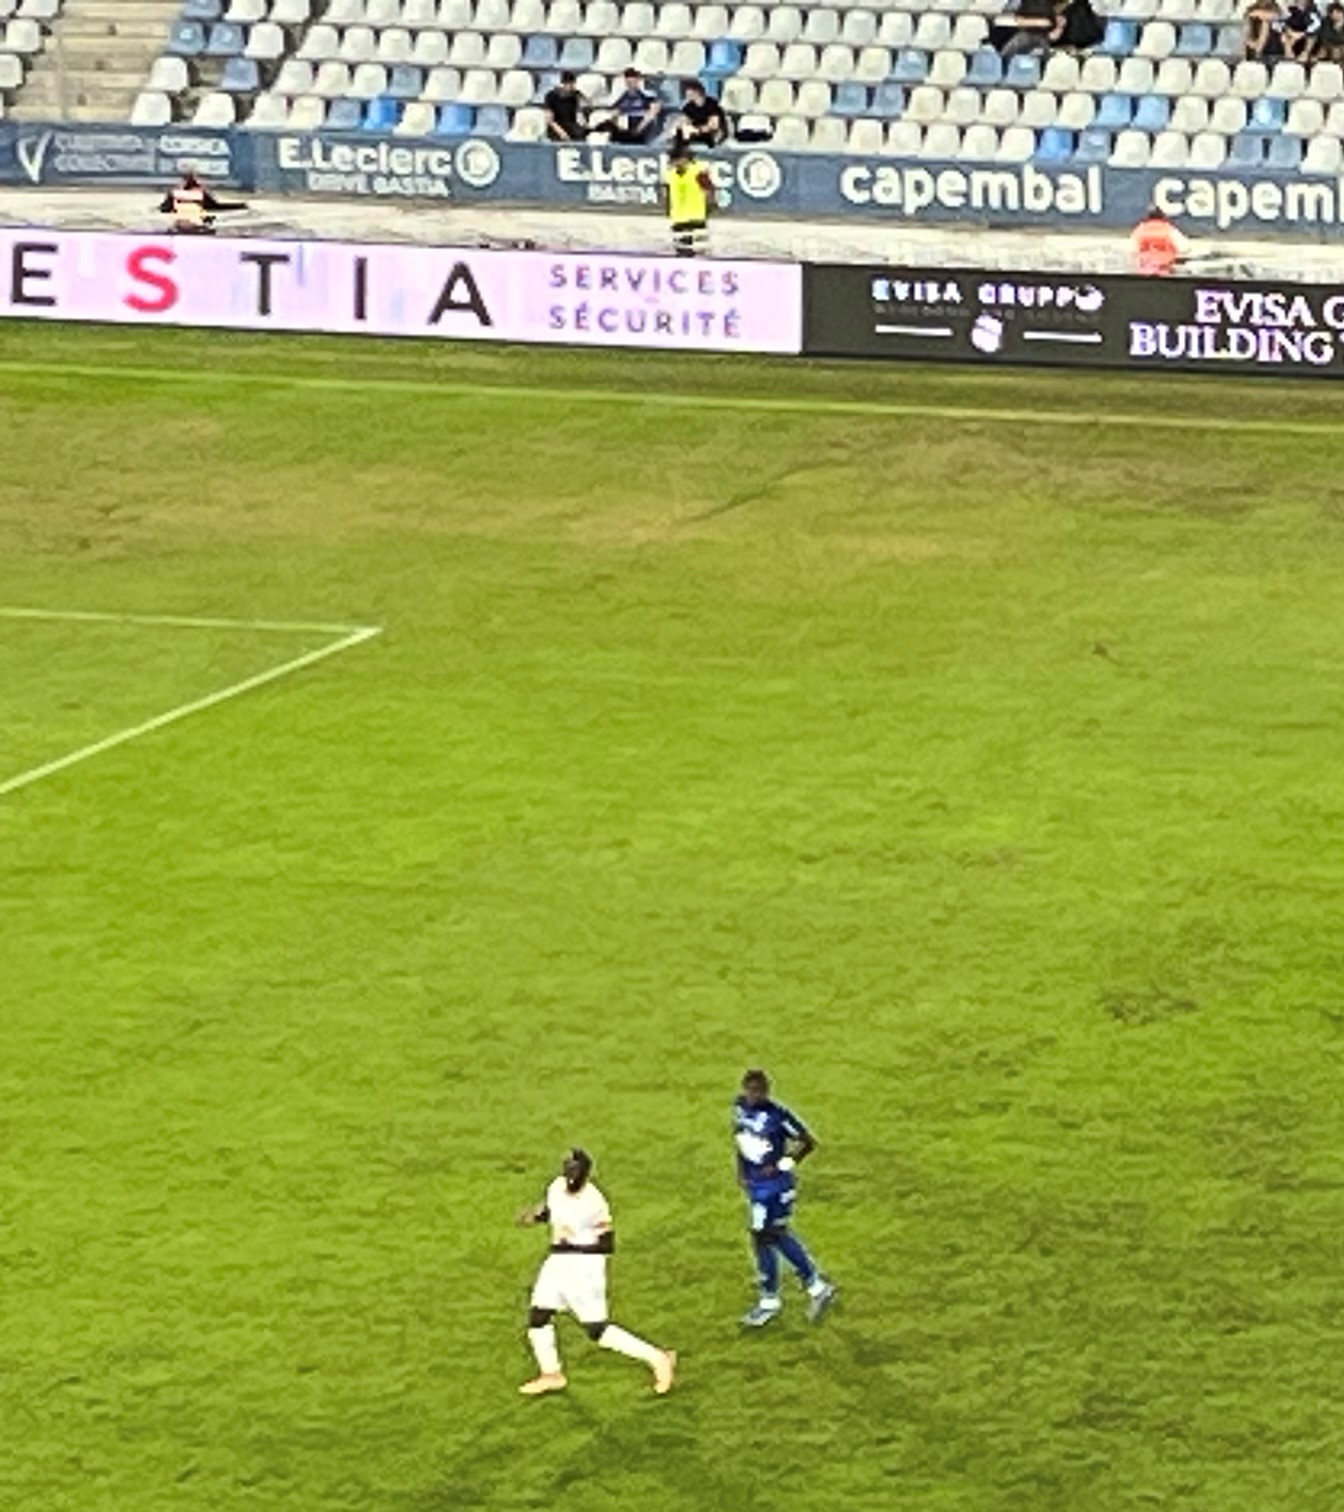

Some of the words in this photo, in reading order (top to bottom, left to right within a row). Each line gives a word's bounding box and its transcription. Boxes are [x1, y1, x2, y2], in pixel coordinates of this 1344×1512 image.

[277, 137, 453, 176] E.Leclerc
[840, 164, 1102, 215] capembal
[11, 241, 494, 328] ESTIA
[549, 263, 740, 296] SERVICES
[871, 278, 963, 304] EVISA
[549, 300, 741, 339] SÉCURITÉ
[1194, 289, 1317, 328] EVISA
[1129, 321, 1335, 364] BUILDING
